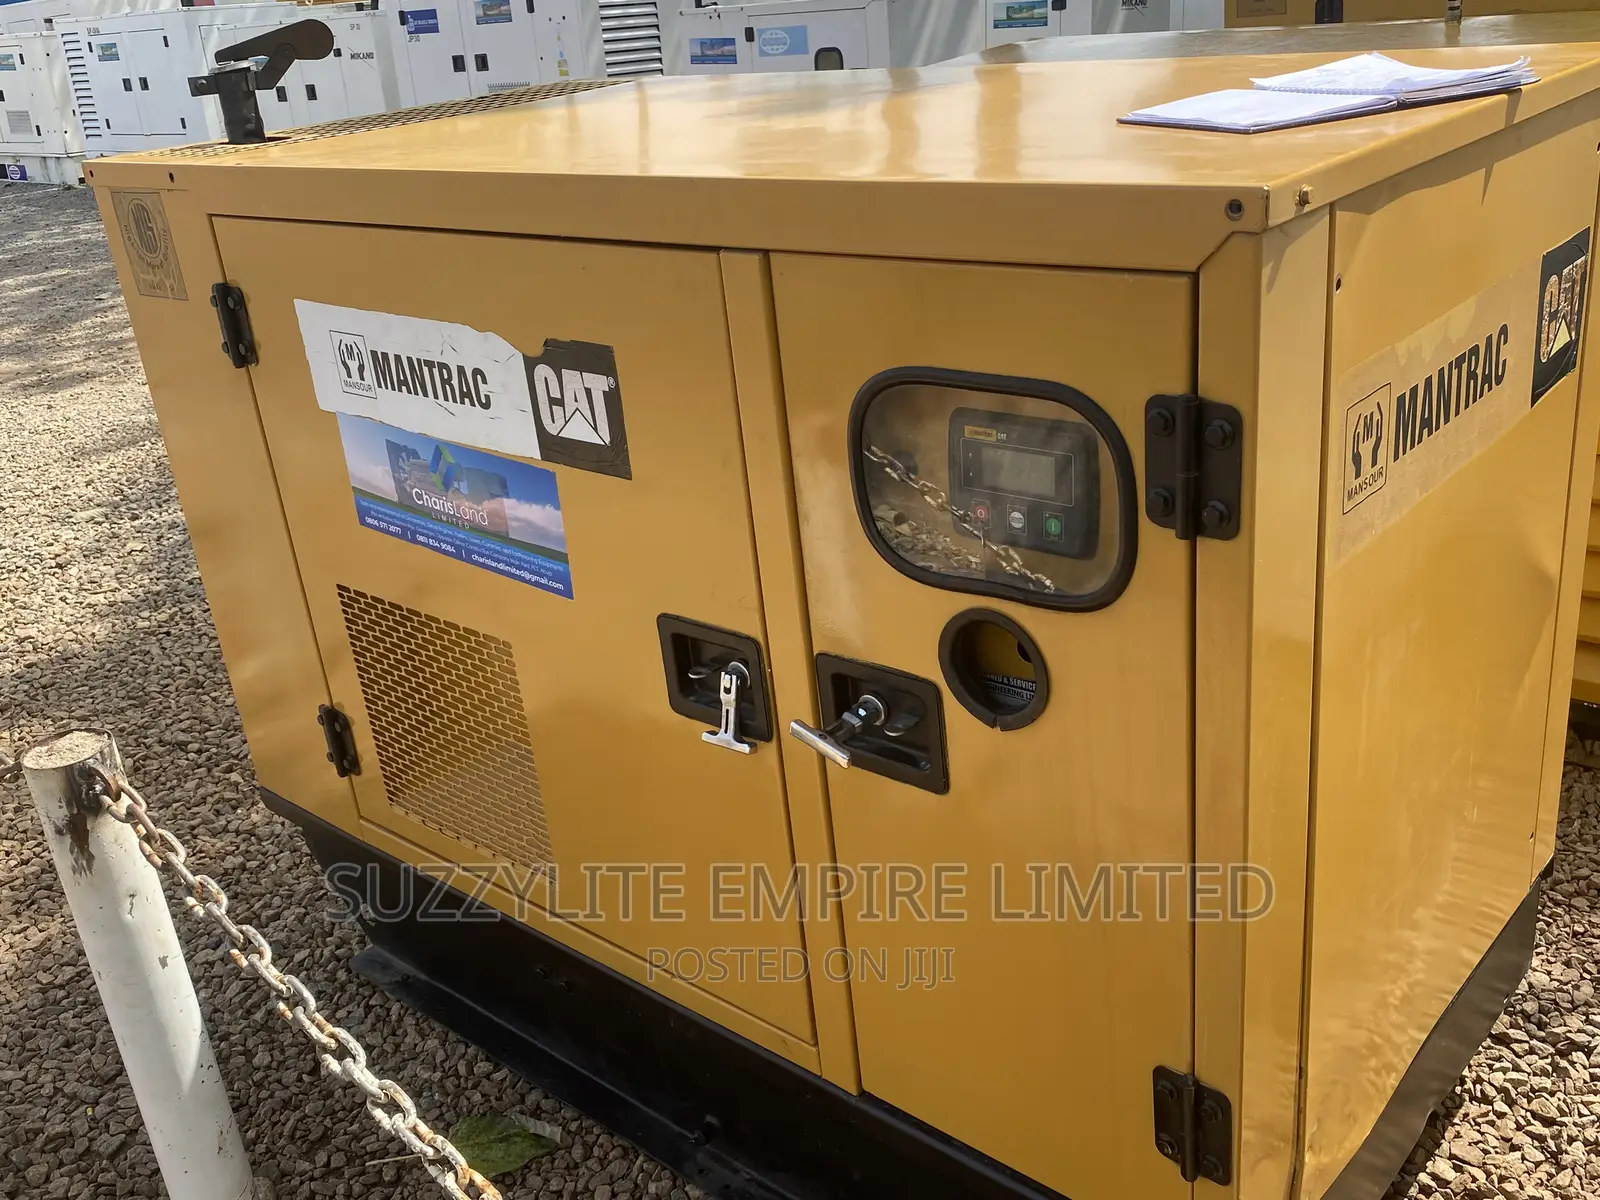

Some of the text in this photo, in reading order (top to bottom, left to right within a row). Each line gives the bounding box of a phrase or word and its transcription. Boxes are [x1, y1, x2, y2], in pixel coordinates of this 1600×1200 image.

[350, 52, 374, 60] MIKANO
[343, 380, 373, 392] MANSOUR
[369, 349, 492, 411] MANTRAC
[1393, 323, 1509, 463] MANTRAC
[1347, 466, 1384, 501] MANSOUR
[412, 487, 489, 526] CharisLand
[432, 511, 470, 530] LIMITED
